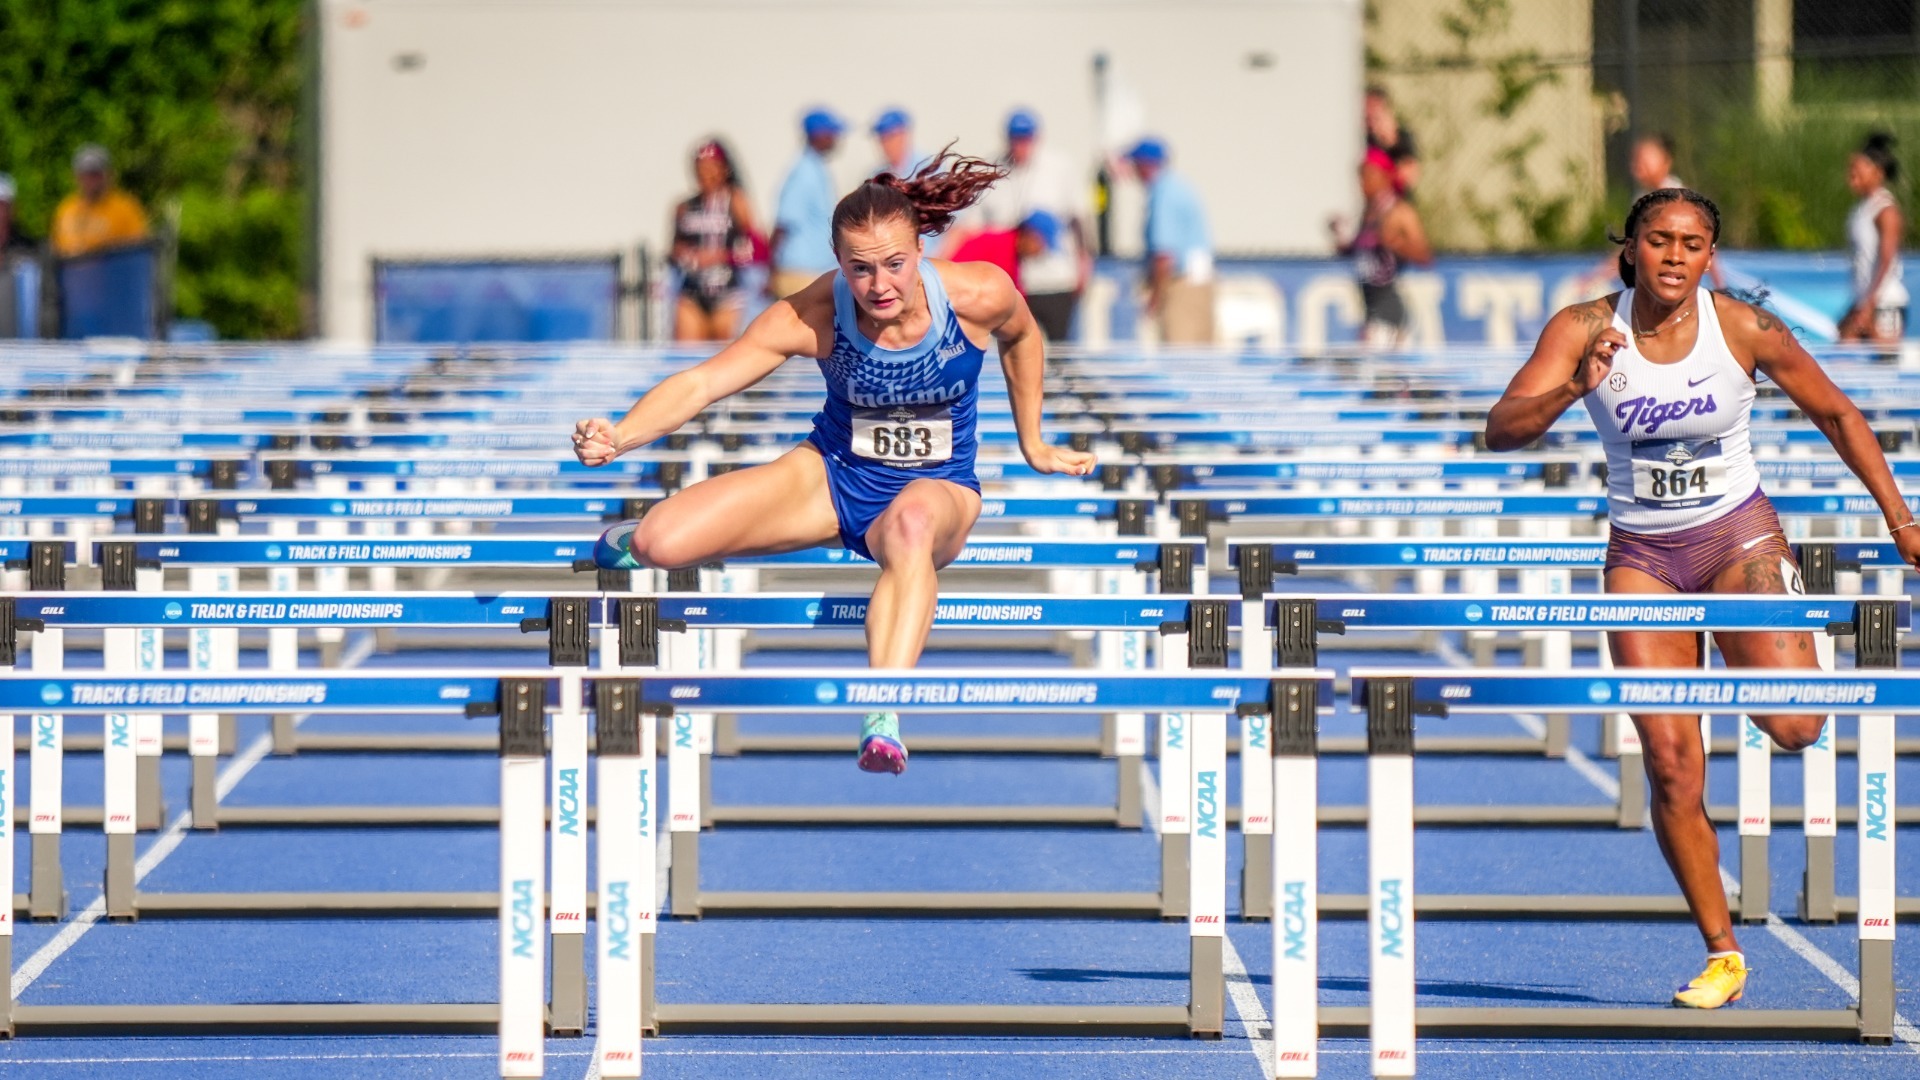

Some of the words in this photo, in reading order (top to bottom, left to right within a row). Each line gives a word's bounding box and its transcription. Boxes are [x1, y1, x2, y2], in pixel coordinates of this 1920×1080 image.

[847, 379, 967, 408] Indiana
[1616, 394, 1717, 434] Tigers
[873, 427, 932, 457] 683
[1651, 466, 1709, 498] 864
[289, 546, 326, 559] TRACK
[327, 546, 338, 559] &
[338, 546, 369, 559] FIELD
[372, 545, 471, 559] CHAMPIONSHIPS
[954, 546, 1032, 562] MPIONSHIPS
[1424, 548, 1462, 561] TRACK
[1462, 548, 1473, 561] &
[1473, 548, 1506, 561] FIELD
[1507, 547, 1607, 562] CHAMPIONSHIPS
[191, 604, 235, 618] TRACK
[236, 604, 247, 618] &
[248, 604, 286, 618] FIELD
[289, 604, 403, 618] CHAMPIONSHIPS
[501, 606, 524, 614] GILL
[684, 607, 707, 615] GILL
[831, 604, 868, 620] TRAC
[1140, 609, 1163, 617] GILL
[1342, 609, 1365, 617] GILL
[1491, 606, 1536, 620] TRACK
[1537, 606, 1548, 621] &
[1549, 606, 1587, 621] FIELD
[1590, 606, 1705, 621] CHAMPIONSHIPS
[1806, 610, 1829, 618] GILL
[73, 684, 126, 704] TRACK
[126, 683, 140, 704] &
[140, 683, 186, 704] FIELD
[187, 684, 326, 703] CHAMPIONSHIPS
[846, 684, 899, 703] TRACK
[899, 683, 913, 704] &
[913, 683, 959, 703] FIELD
[960, 683, 1097, 702] CHAMPIONSHIPS
[1620, 683, 1674, 703] TRACK
[1674, 683, 1687, 703] &
[1687, 683, 1735, 703] FIELD
[1737, 684, 1876, 703] CHAMPIONSHIPS
[38, 714, 55, 748] NC
[112, 714, 128, 747] NC
[676, 713, 692, 748] NC
[1167, 713, 1183, 749] NC
[1250, 715, 1265, 748] NC
[559, 768, 578, 836] NCAA
[1197, 771, 1217, 838] NCAA
[1866, 772, 1886, 841] NCAA
[512, 880, 533, 958] NCAA
[608, 881, 629, 960] NCAA
[1284, 881, 1306, 960] NCAA
[1380, 879, 1402, 958] NCAA
[506, 1052, 534, 1061] GILL
[605, 1052, 633, 1060] GILL
[1281, 1052, 1309, 1061] GILL
[1378, 1050, 1406, 1059] GILL
